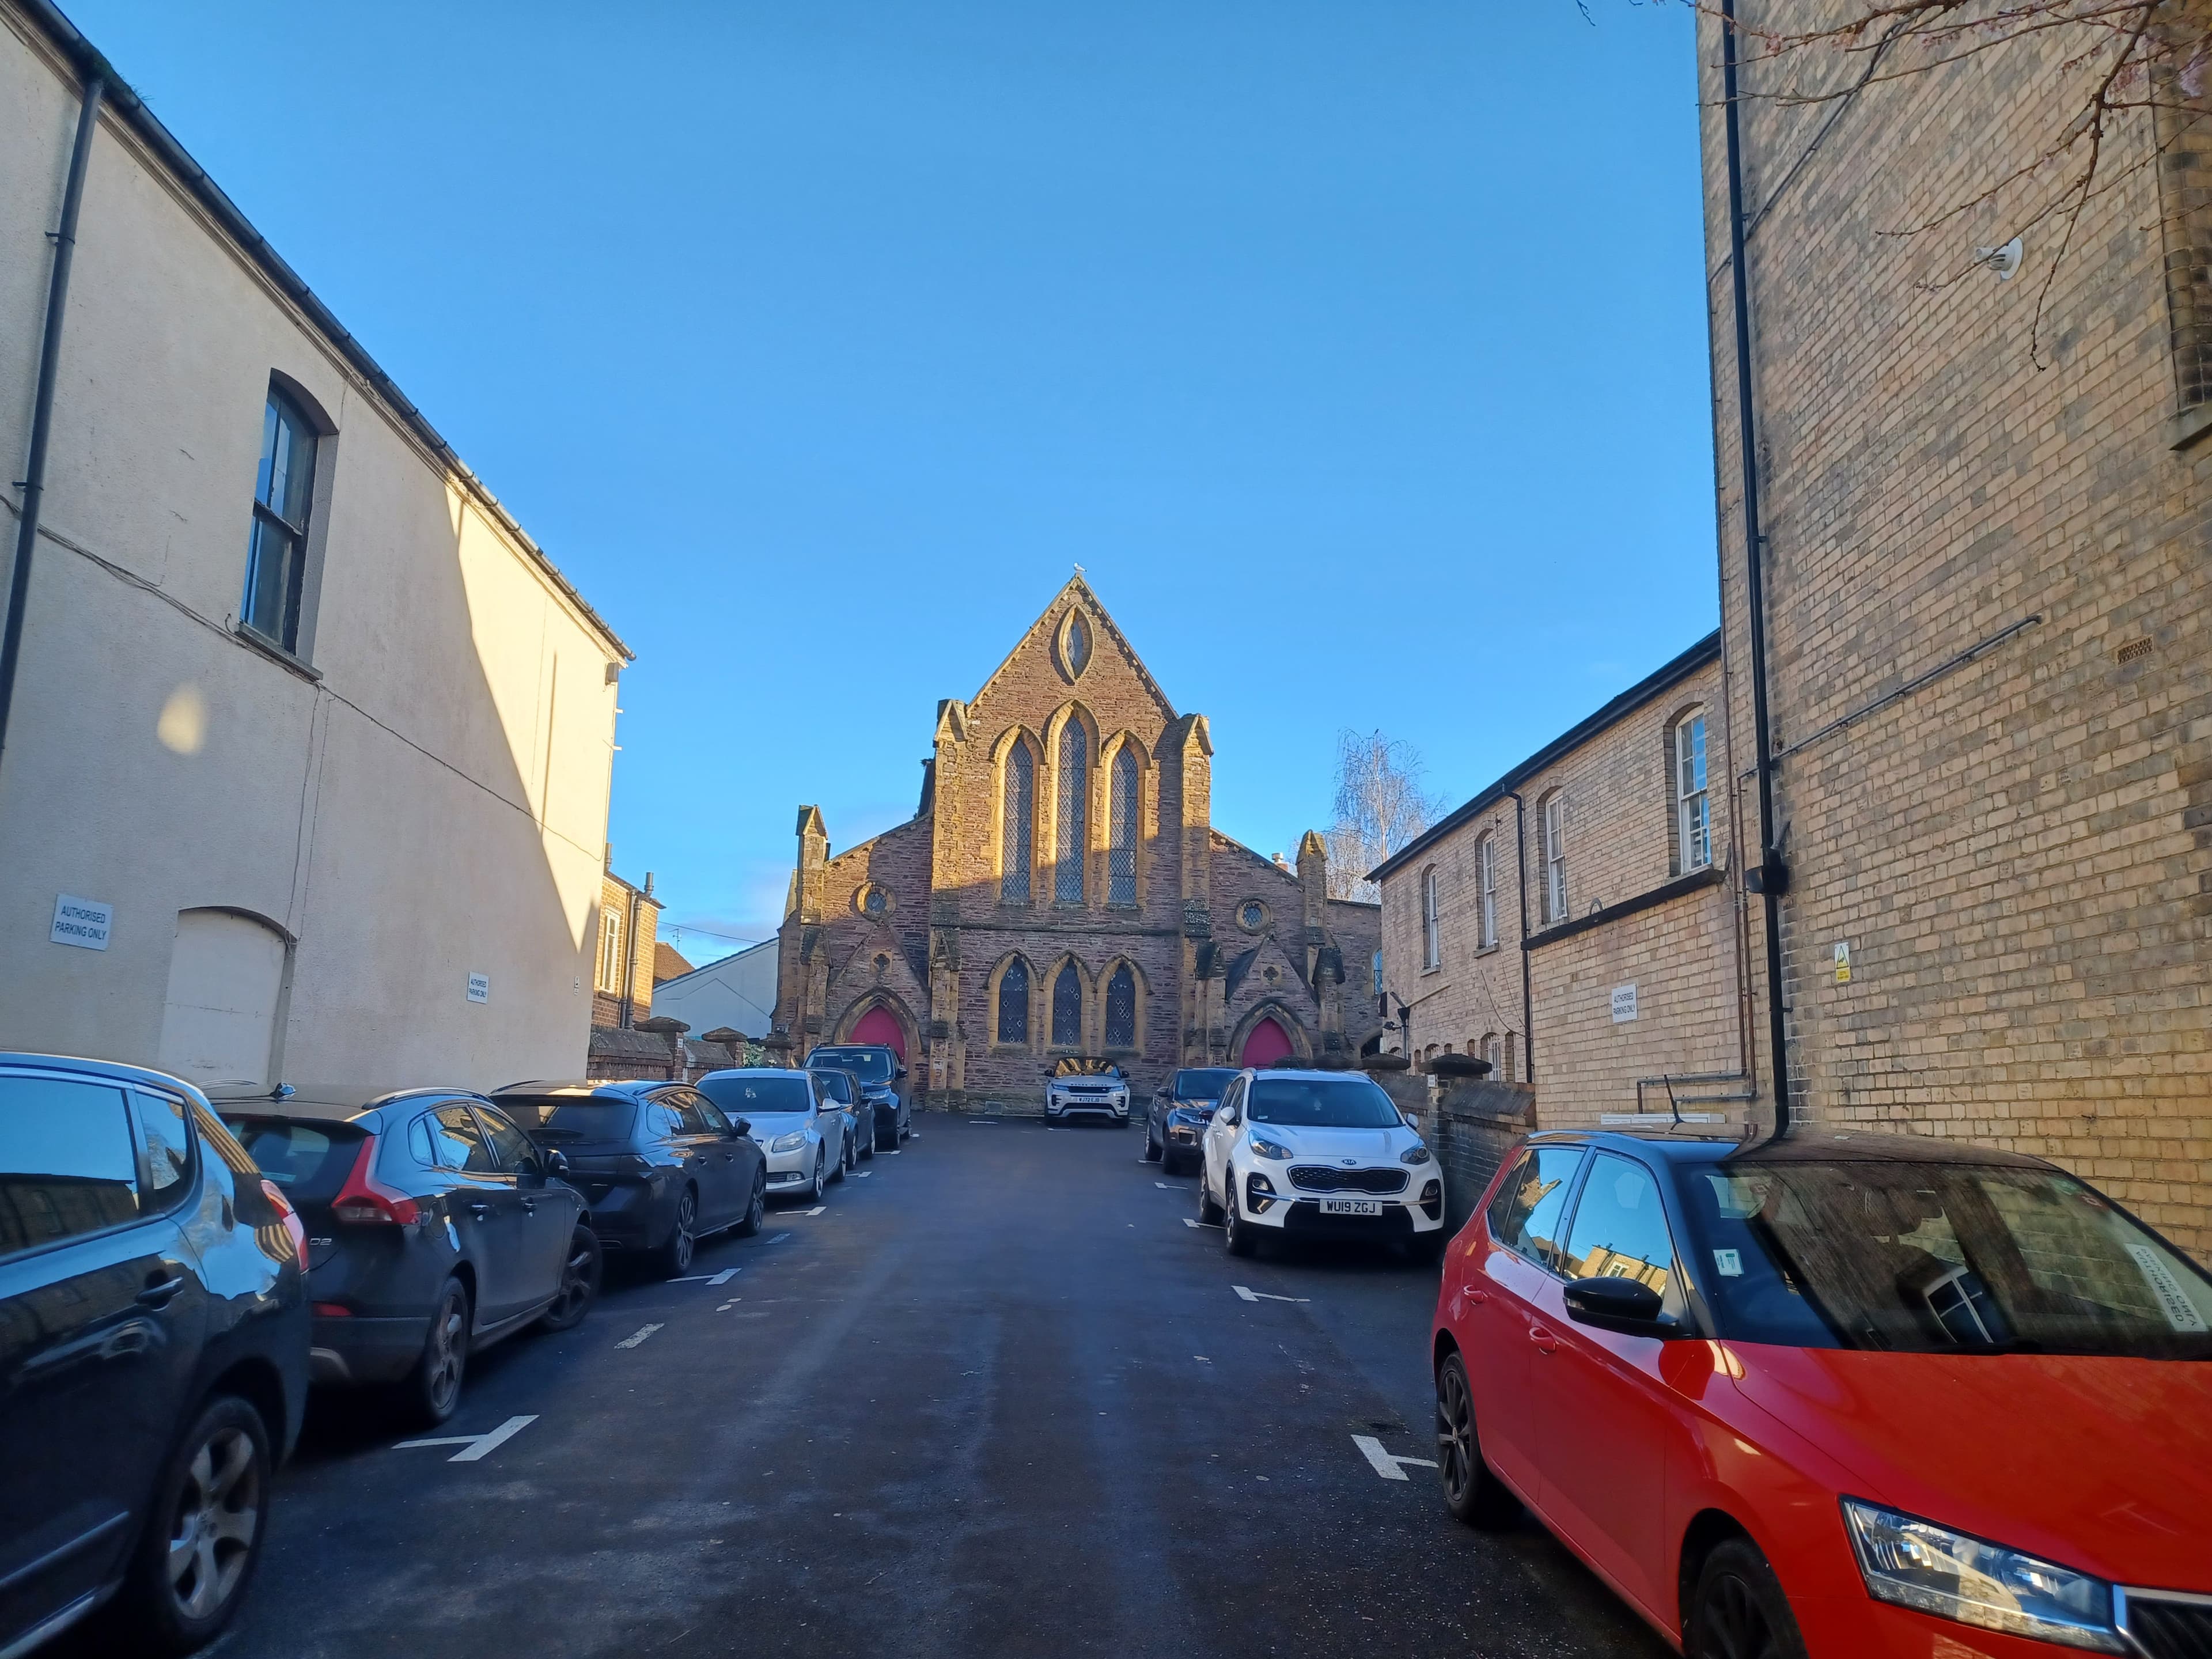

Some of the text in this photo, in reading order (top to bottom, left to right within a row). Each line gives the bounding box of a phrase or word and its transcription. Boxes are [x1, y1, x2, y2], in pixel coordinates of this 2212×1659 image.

[60, 905, 106, 923] AUTHORISED
[55, 921, 107, 940] PARKING ONLY
[1327, 1200, 1376, 1213] WU19 ZGJ
